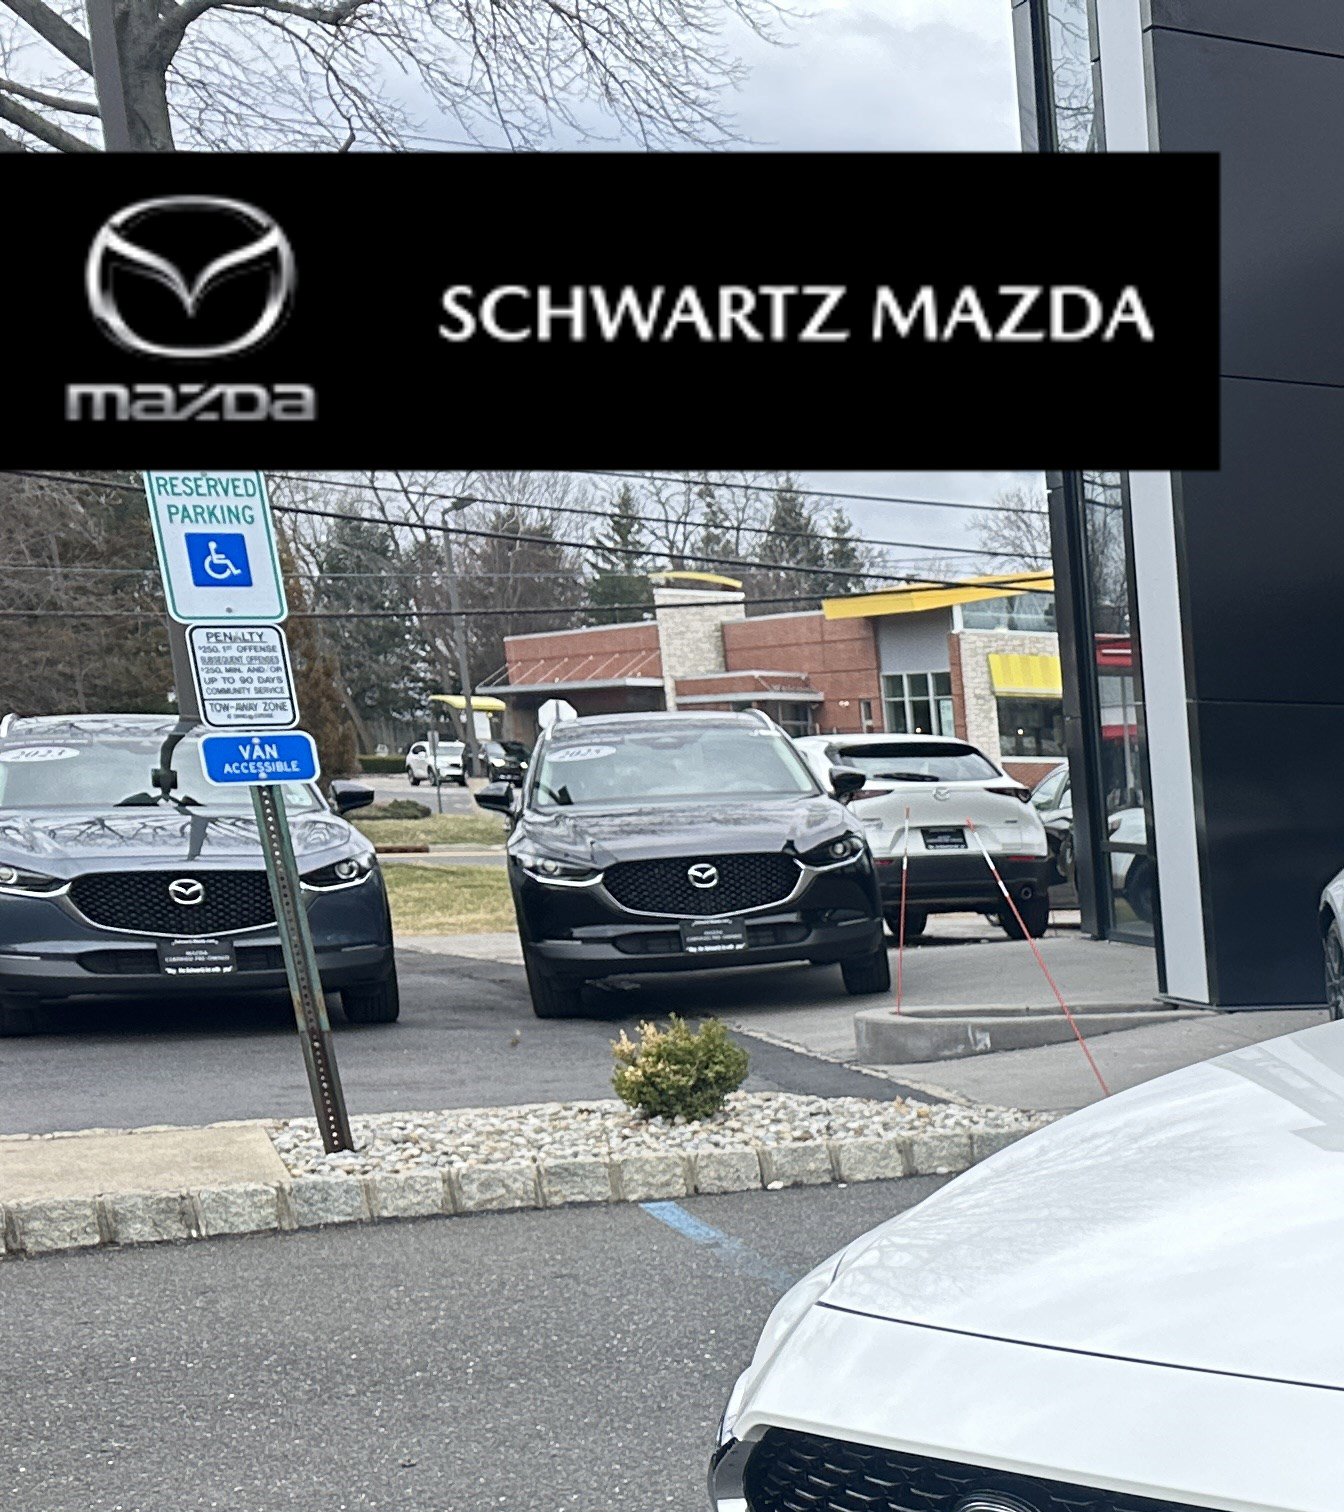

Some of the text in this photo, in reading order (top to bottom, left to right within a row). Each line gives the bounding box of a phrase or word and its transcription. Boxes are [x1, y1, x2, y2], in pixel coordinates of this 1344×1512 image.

[155, 476, 257, 497] RESERVED
[166, 504, 255, 524] PARKING
[205, 631, 265, 642] PENALTY
[236, 645, 278, 653] OFFENSE
[203, 676, 283, 684] UP TO 90 DAYS
[205, 686, 285, 695] COMMUNITY SERVICE
[209, 702, 288, 713] TOW-AWAY ZONE
[238, 744, 278, 760] VAN
[223, 760, 300, 774] ACCESSIBLE
